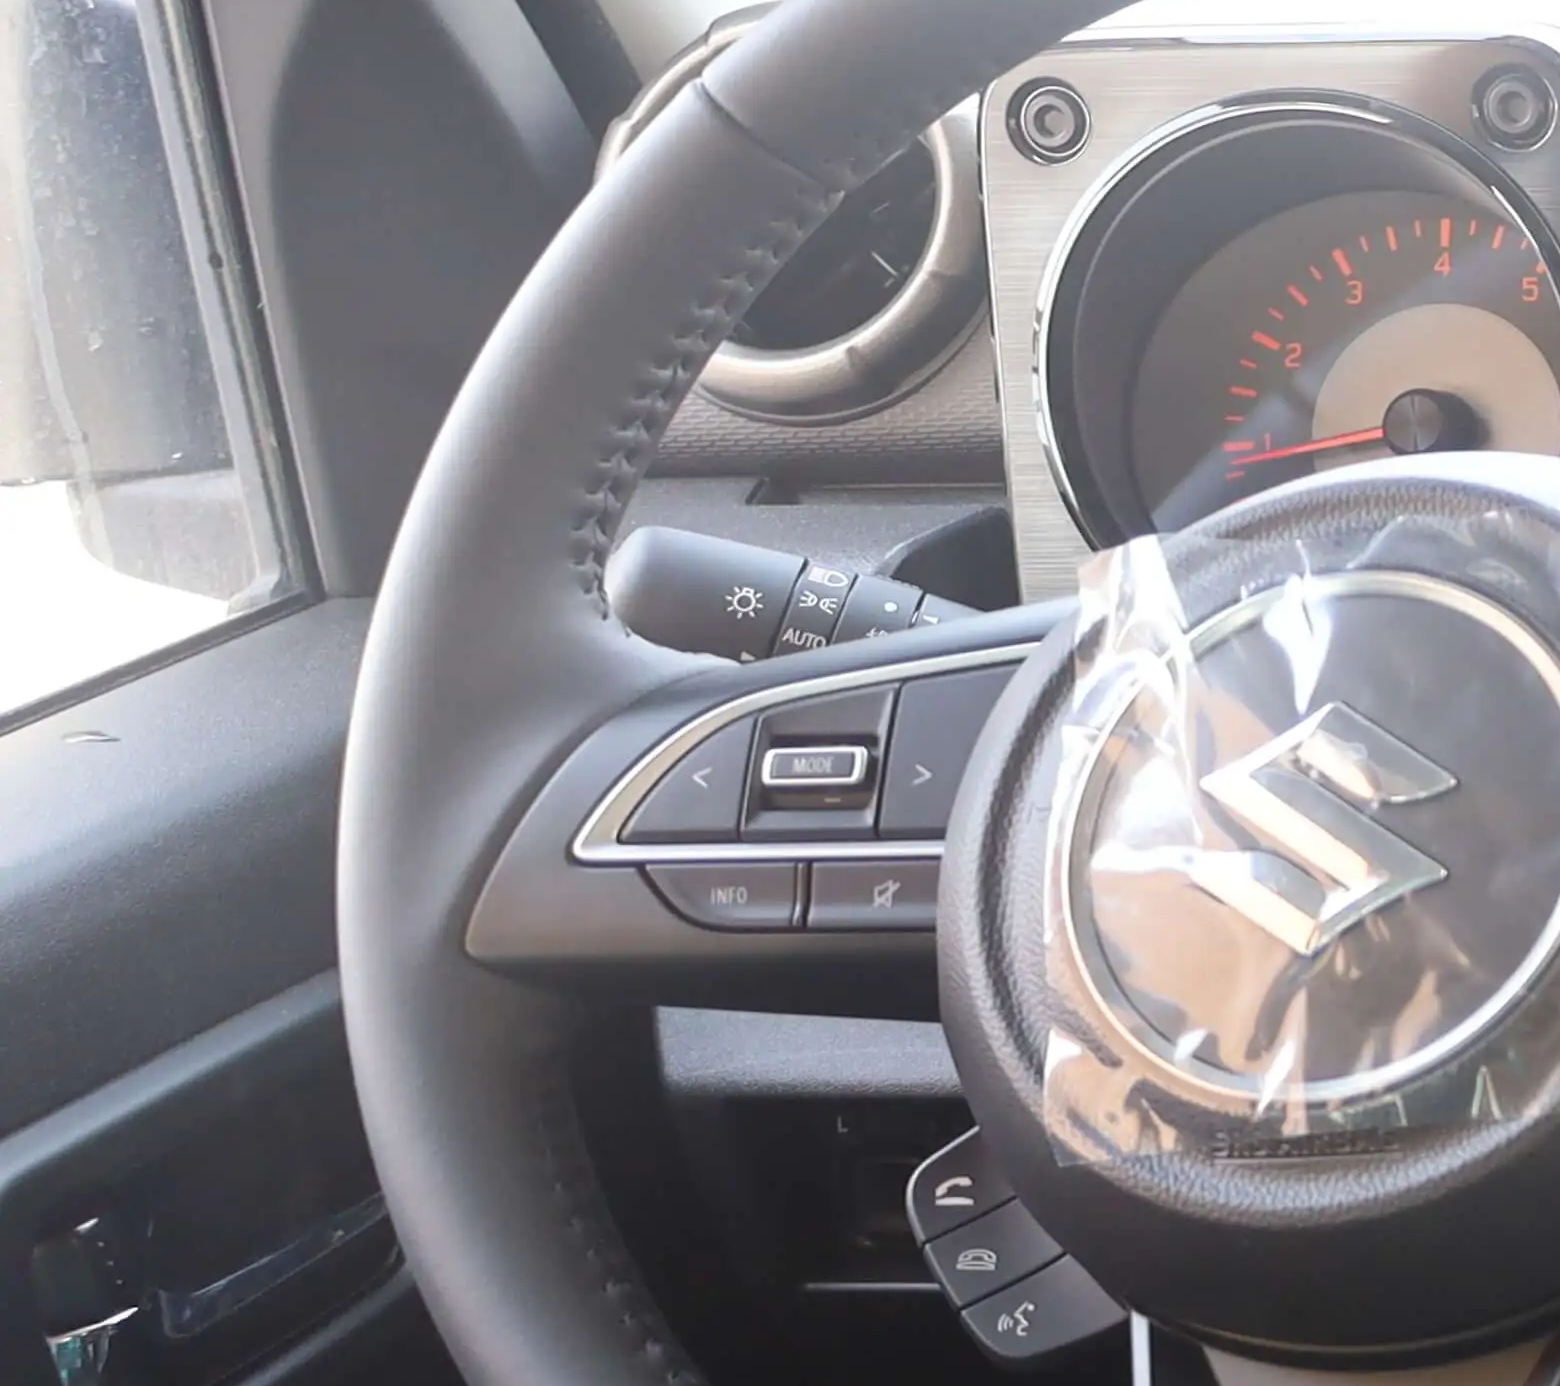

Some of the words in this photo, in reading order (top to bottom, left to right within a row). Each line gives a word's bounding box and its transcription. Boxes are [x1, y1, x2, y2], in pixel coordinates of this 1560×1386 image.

[1433, 252, 1452, 276] 4
[1345, 281, 1363, 305] 3
[1522, 276, 1539, 301] 5
[1284, 342, 1302, 367] 2
[782, 626, 827, 649] AUTO
[791, 755, 834, 774] MODE
[710, 886, 748, 905] INFO
